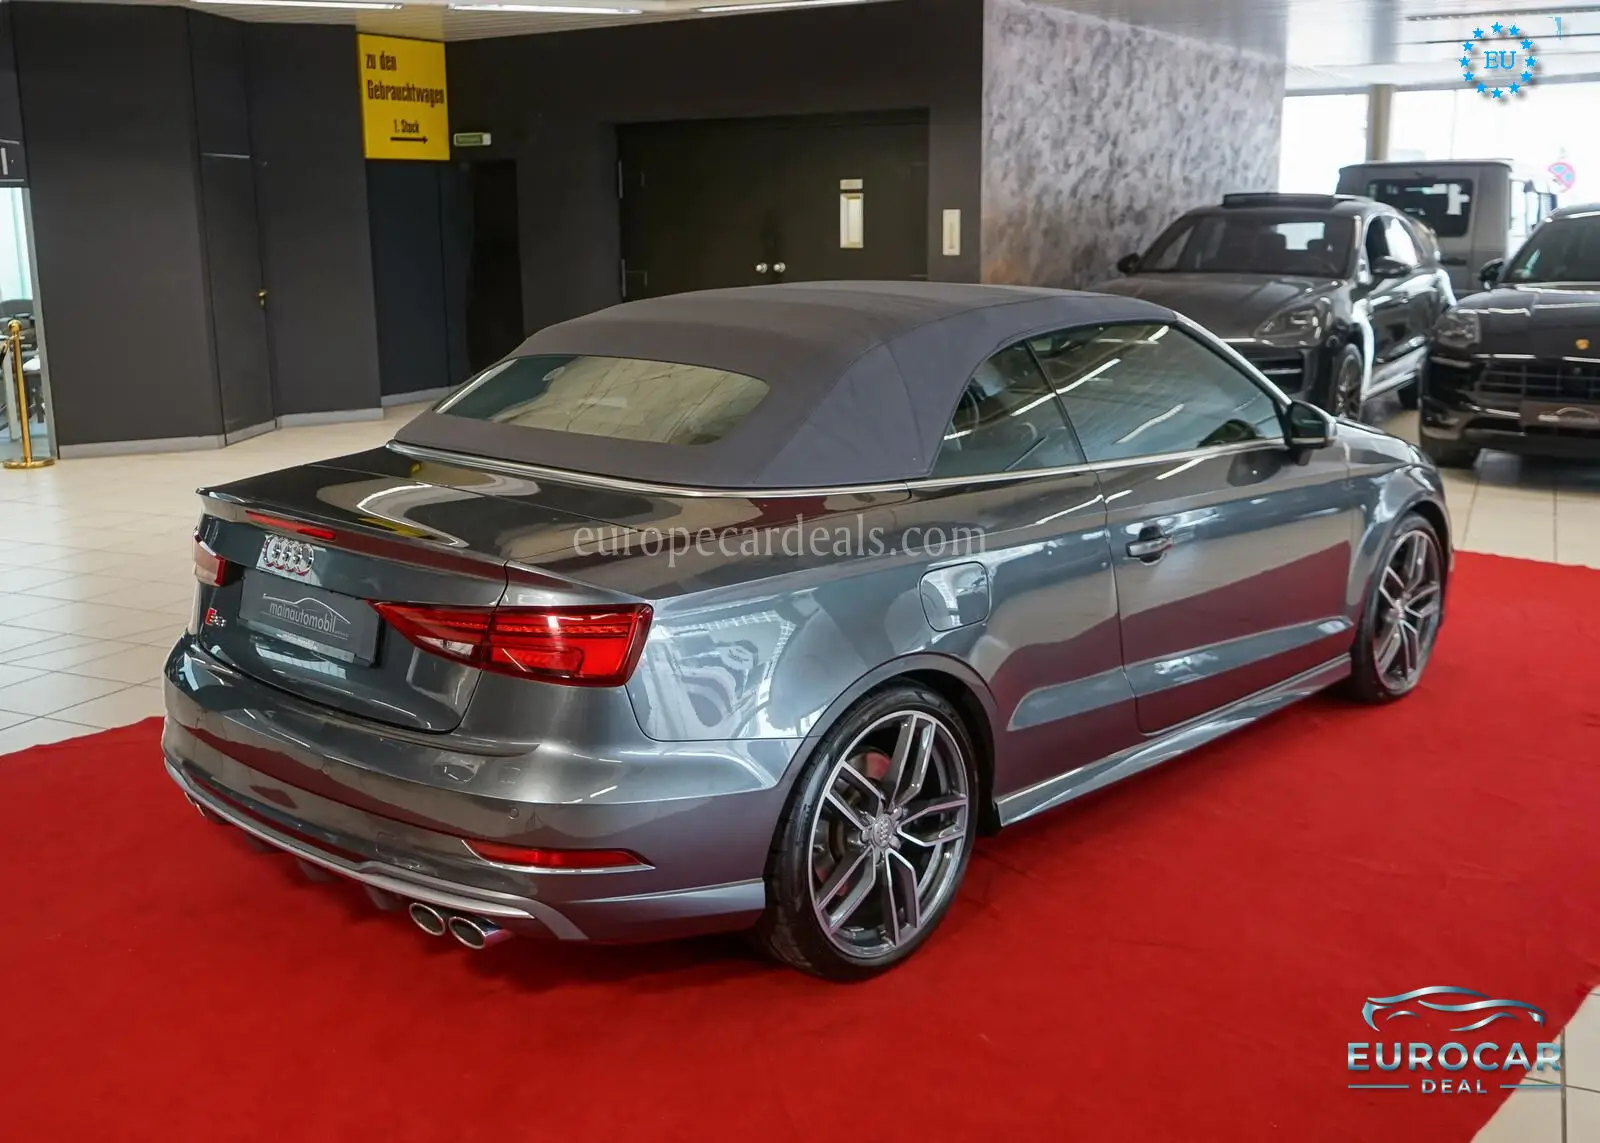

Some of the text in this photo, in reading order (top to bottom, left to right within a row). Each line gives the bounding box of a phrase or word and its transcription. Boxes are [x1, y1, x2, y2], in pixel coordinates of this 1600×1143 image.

[366, 50, 398, 71] zu den
[367, 79, 445, 108] Gebrauchtwagen
[401, 119, 420, 134] Stock
[269, 602, 337, 633] mainautomobil
